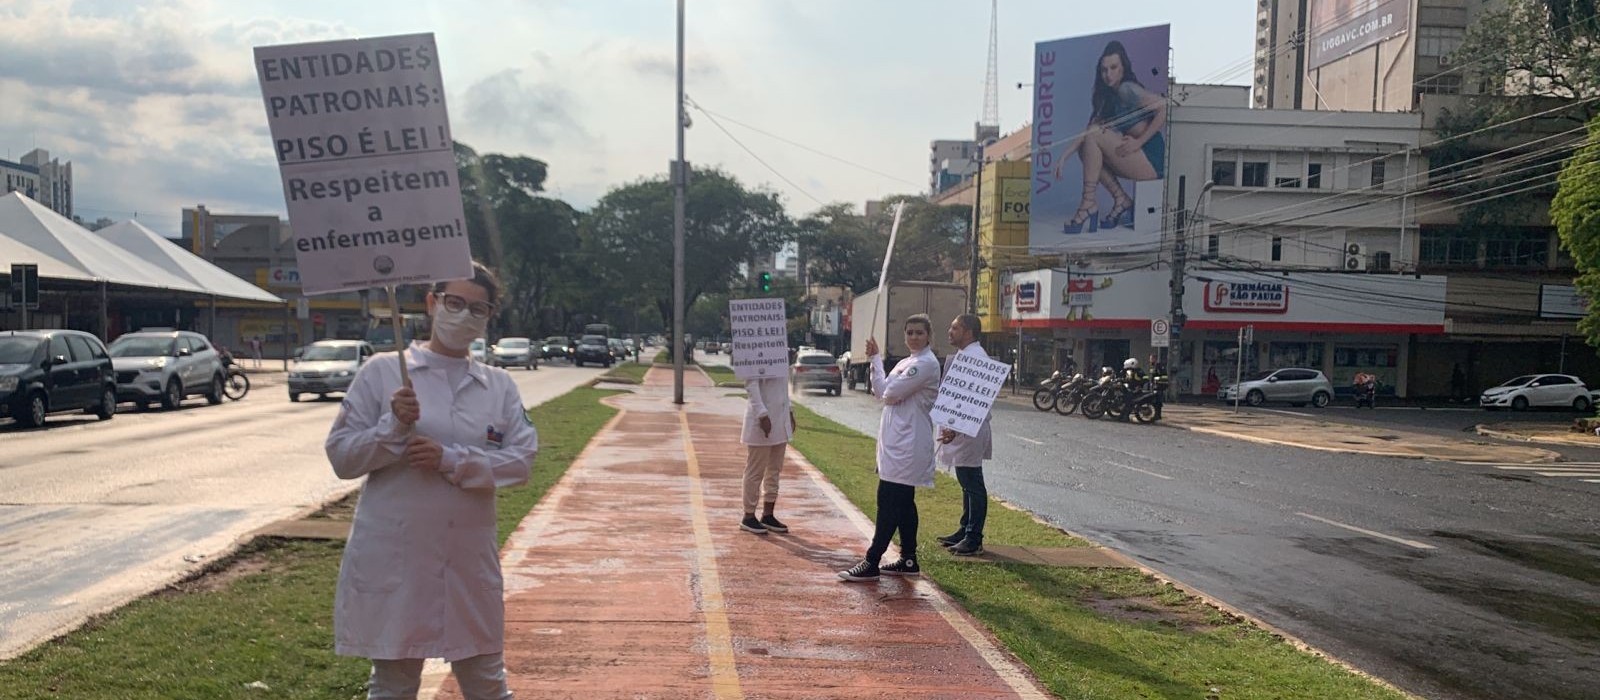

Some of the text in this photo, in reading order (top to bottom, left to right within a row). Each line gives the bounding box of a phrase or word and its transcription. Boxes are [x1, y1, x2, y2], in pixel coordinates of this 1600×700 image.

[1322, 13, 1393, 52] LIGGAVC.COM.BR
[277, 134, 348, 161] PISO
[358, 127, 376, 154] É
[384, 126, 429, 151] LEI
[288, 169, 450, 202] Respeitem
[367, 205, 383, 222] a
[296, 218, 463, 252] enfermagem!
[1230, 282, 1282, 291] FARMÁCIAS
[1230, 290, 1282, 300] SÃO PAULO
[732, 328, 754, 337] PISO
[765, 327, 779, 336] LEI
[734, 340, 785, 350] Respeitem
[734, 356, 787, 367] enfermagem!
[944, 375, 966, 388] PISO
[975, 385, 991, 396] LEI
[940, 386, 989, 409] Respeitem
